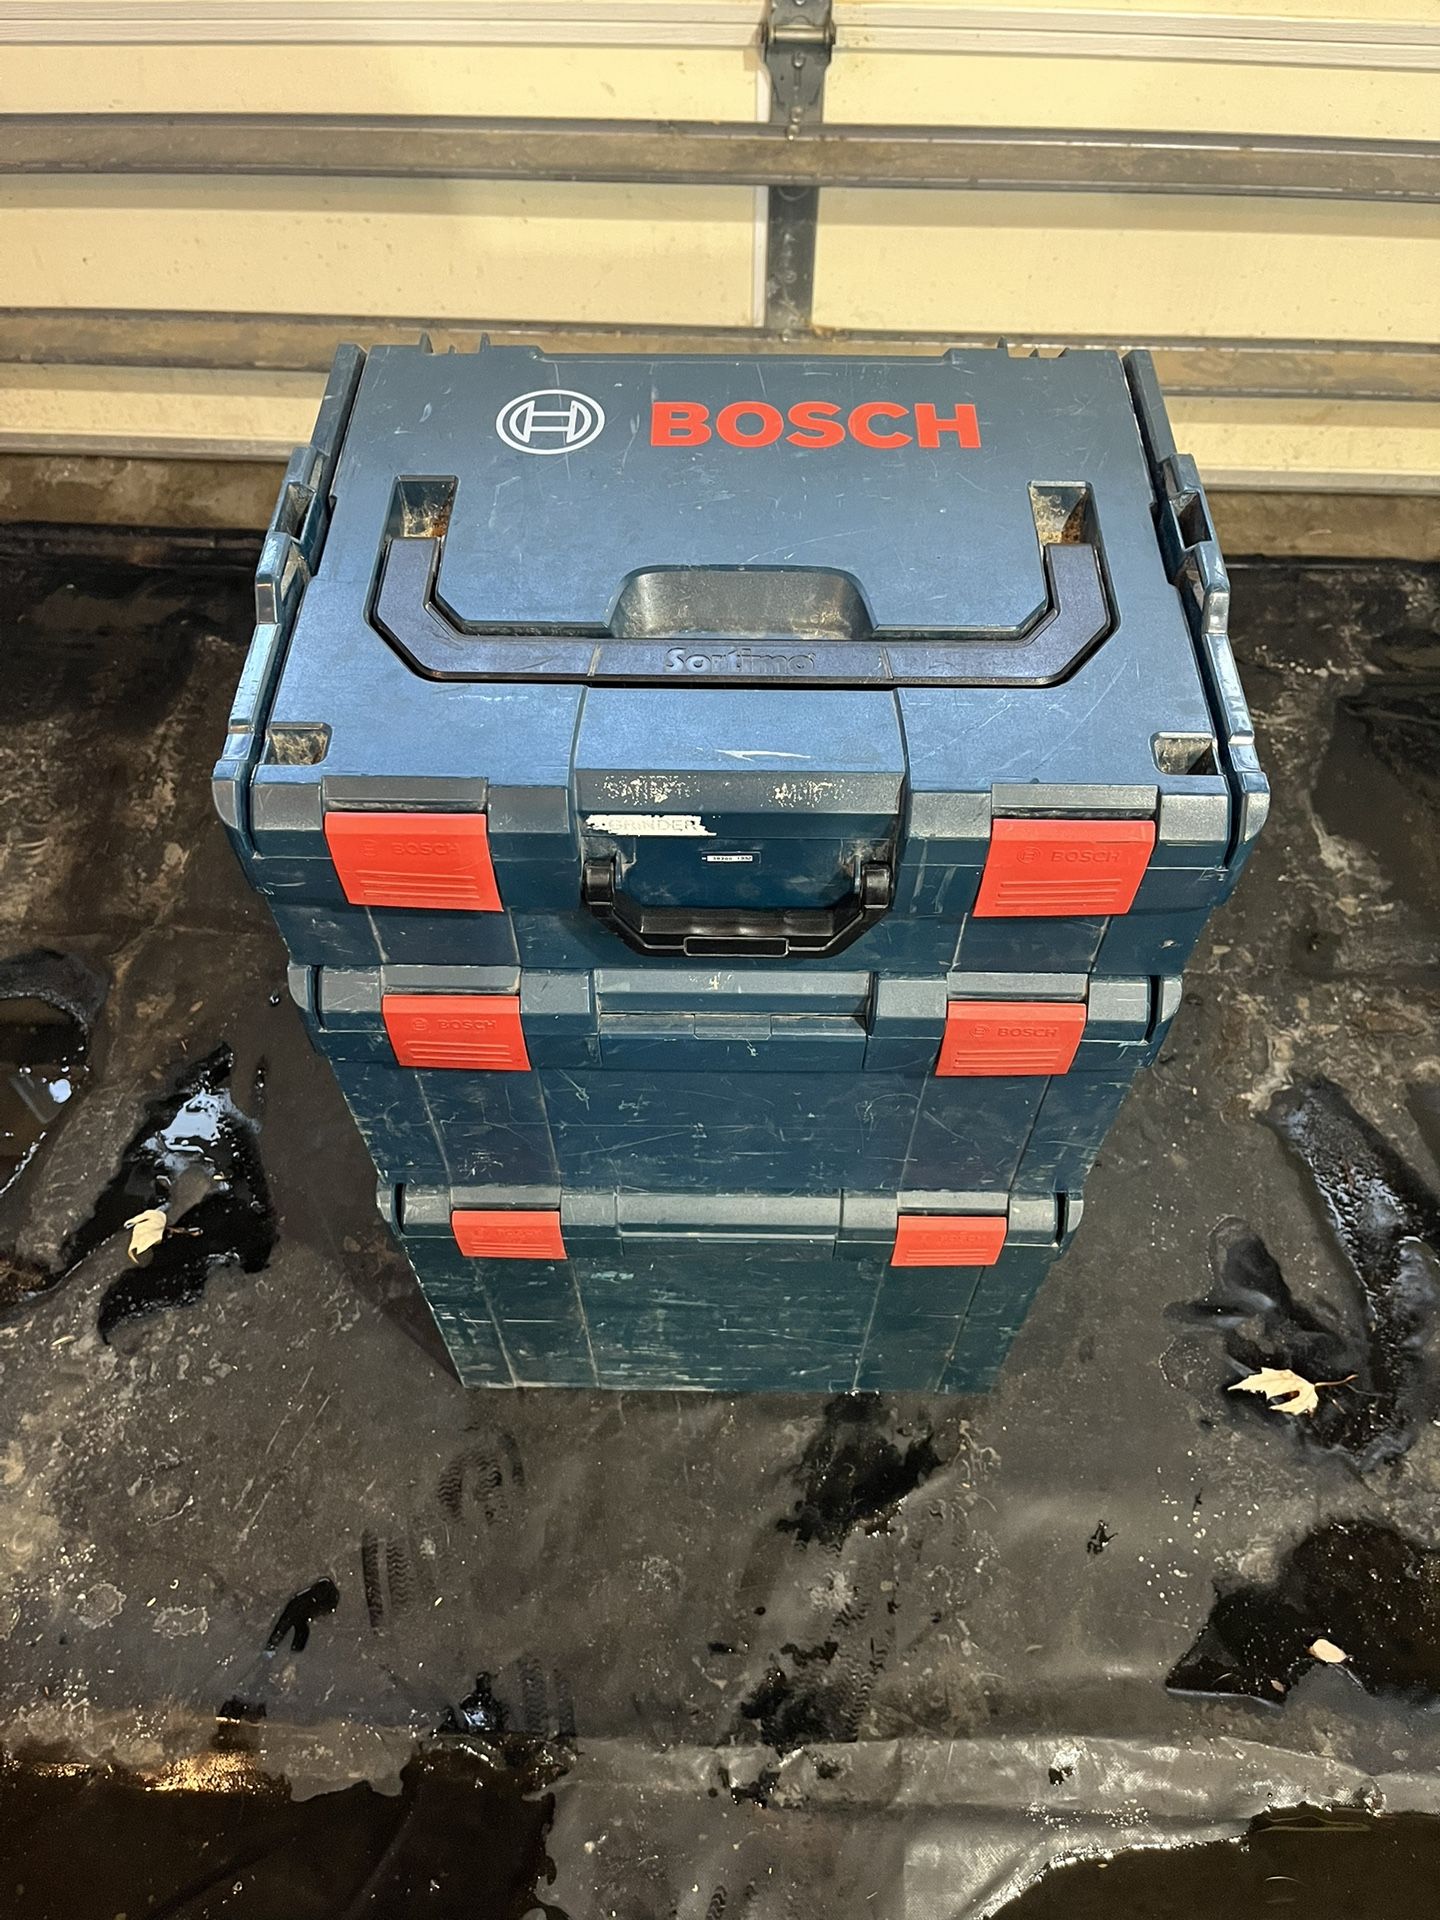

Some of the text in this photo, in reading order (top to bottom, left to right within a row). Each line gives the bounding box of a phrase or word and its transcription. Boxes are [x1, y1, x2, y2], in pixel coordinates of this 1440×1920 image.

[651, 400, 982, 449] BOSCH
[391, 841, 461, 857] BOSCH
[1050, 850, 1121, 864] BOSCH
[437, 1019, 497, 1031] BOSCH
[996, 1026, 1060, 1038] BOSCH
